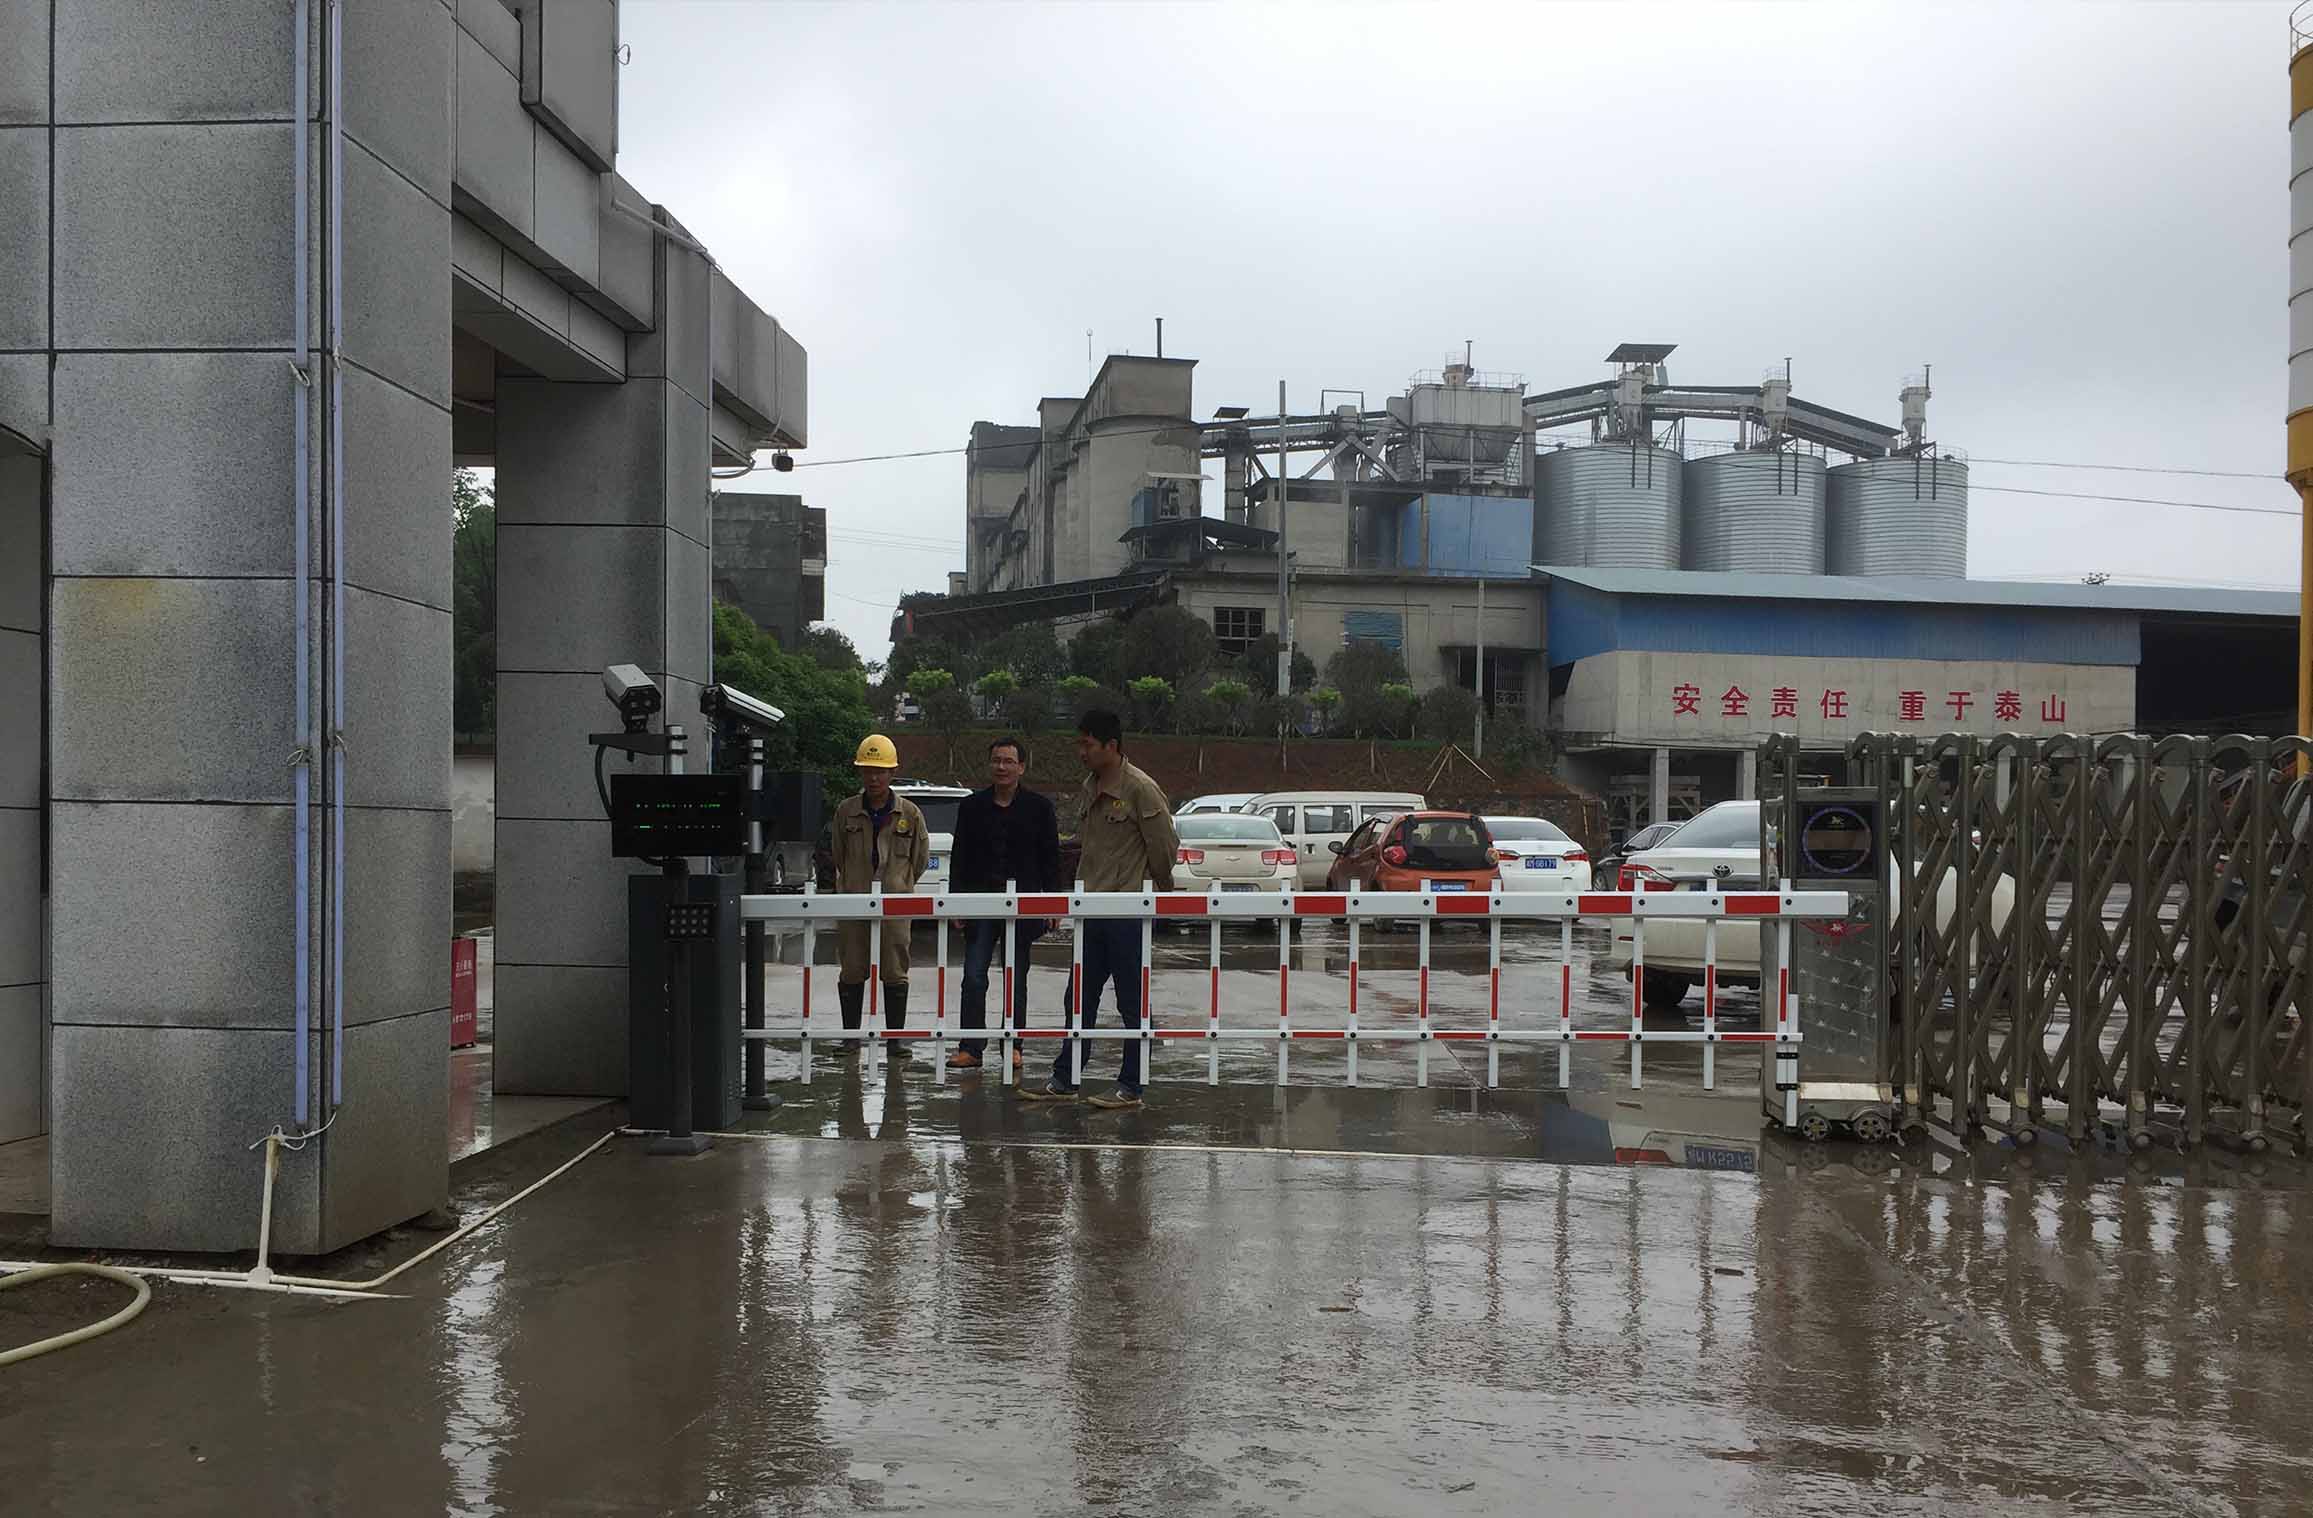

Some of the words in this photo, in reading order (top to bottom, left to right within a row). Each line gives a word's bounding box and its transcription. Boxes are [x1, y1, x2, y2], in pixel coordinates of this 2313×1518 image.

[1672, 683, 1848, 719] 安全责任
[1899, 690, 2066, 722] 重于泰山
